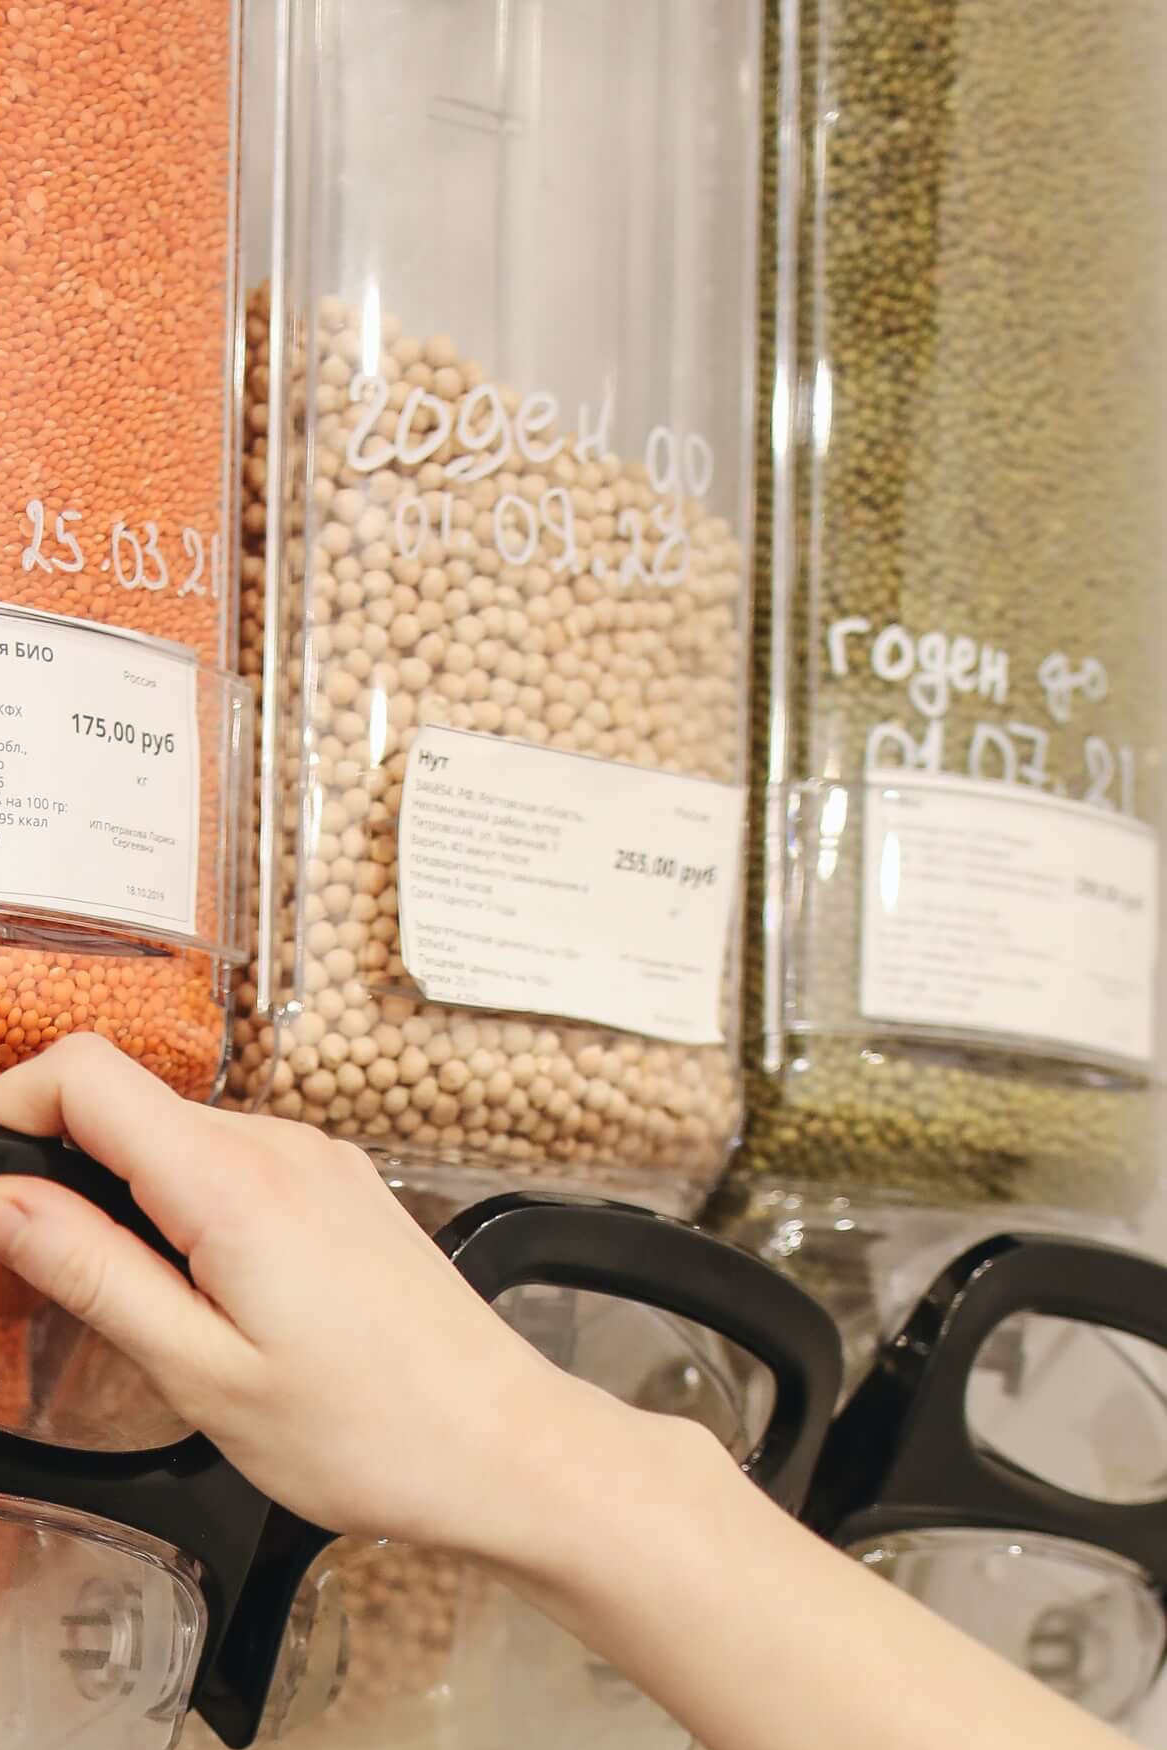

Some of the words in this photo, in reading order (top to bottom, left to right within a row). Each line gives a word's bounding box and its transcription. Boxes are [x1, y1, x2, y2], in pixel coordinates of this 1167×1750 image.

[15, 641, 55, 663] БИО
[71, 712, 135, 744] 175,00
[141, 731, 175, 756] руб
[418, 749, 450, 772] Нут
[6, 798, 22, 809] на
[27, 797, 49, 810] 100
[18, 815, 48, 828] ккал
[680, 863, 718, 889] руб
